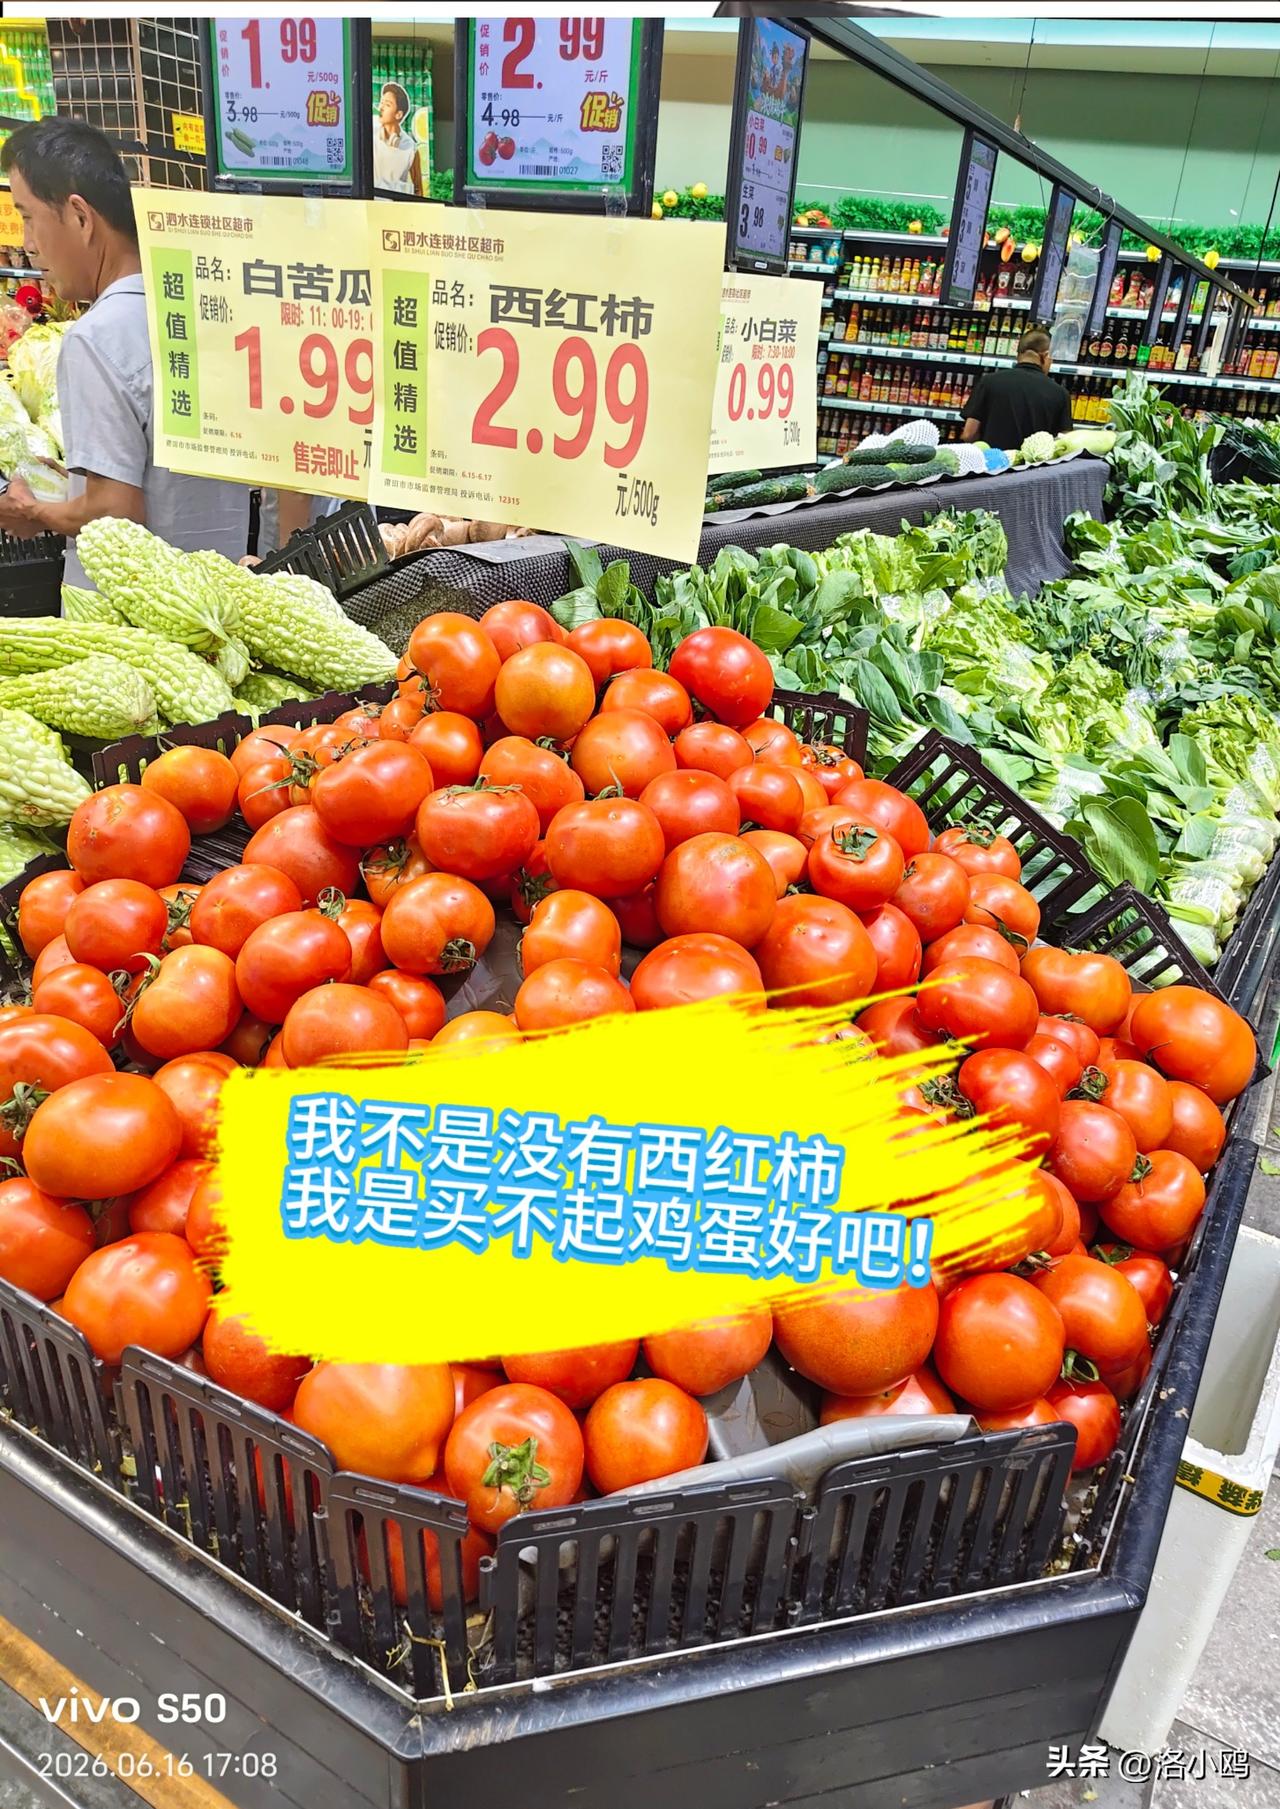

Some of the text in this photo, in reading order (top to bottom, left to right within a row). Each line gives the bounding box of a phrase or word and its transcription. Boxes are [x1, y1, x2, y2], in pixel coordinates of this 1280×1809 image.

[480, 24, 490, 76] 促销价
[307, 71, 339, 84] 元/500g
[584, 70, 609, 83] 元/斤
[226, 100, 258, 123] 3.98
[481, 101, 520, 127] 4.98
[581, 91, 623, 131] 促销
[166, 212, 253, 233] 泗水连锁社区超市
[403, 231, 505, 255] 泗水连锁社区超市
[195, 255, 372, 307] 品名： 白苦瓜
[199, 293, 233, 324] 促销价：
[432, 279, 655, 340] 品名： 西红柿
[163, 271, 192, 417] 超值精选
[433, 320, 474, 354] 促销价：
[740, 316, 798, 343] 小白菜
[235, 326, 374, 425] 1.99
[393, 295, 418, 455] 超值精选
[728, 363, 794, 421] 0.99
[471, 327, 649, 469] 2.99
[261, 453, 280, 463] 12315
[293, 440, 360, 481] 售完即止
[498, 496, 520, 506] 12315
[615, 473, 660, 527] 元/500g
